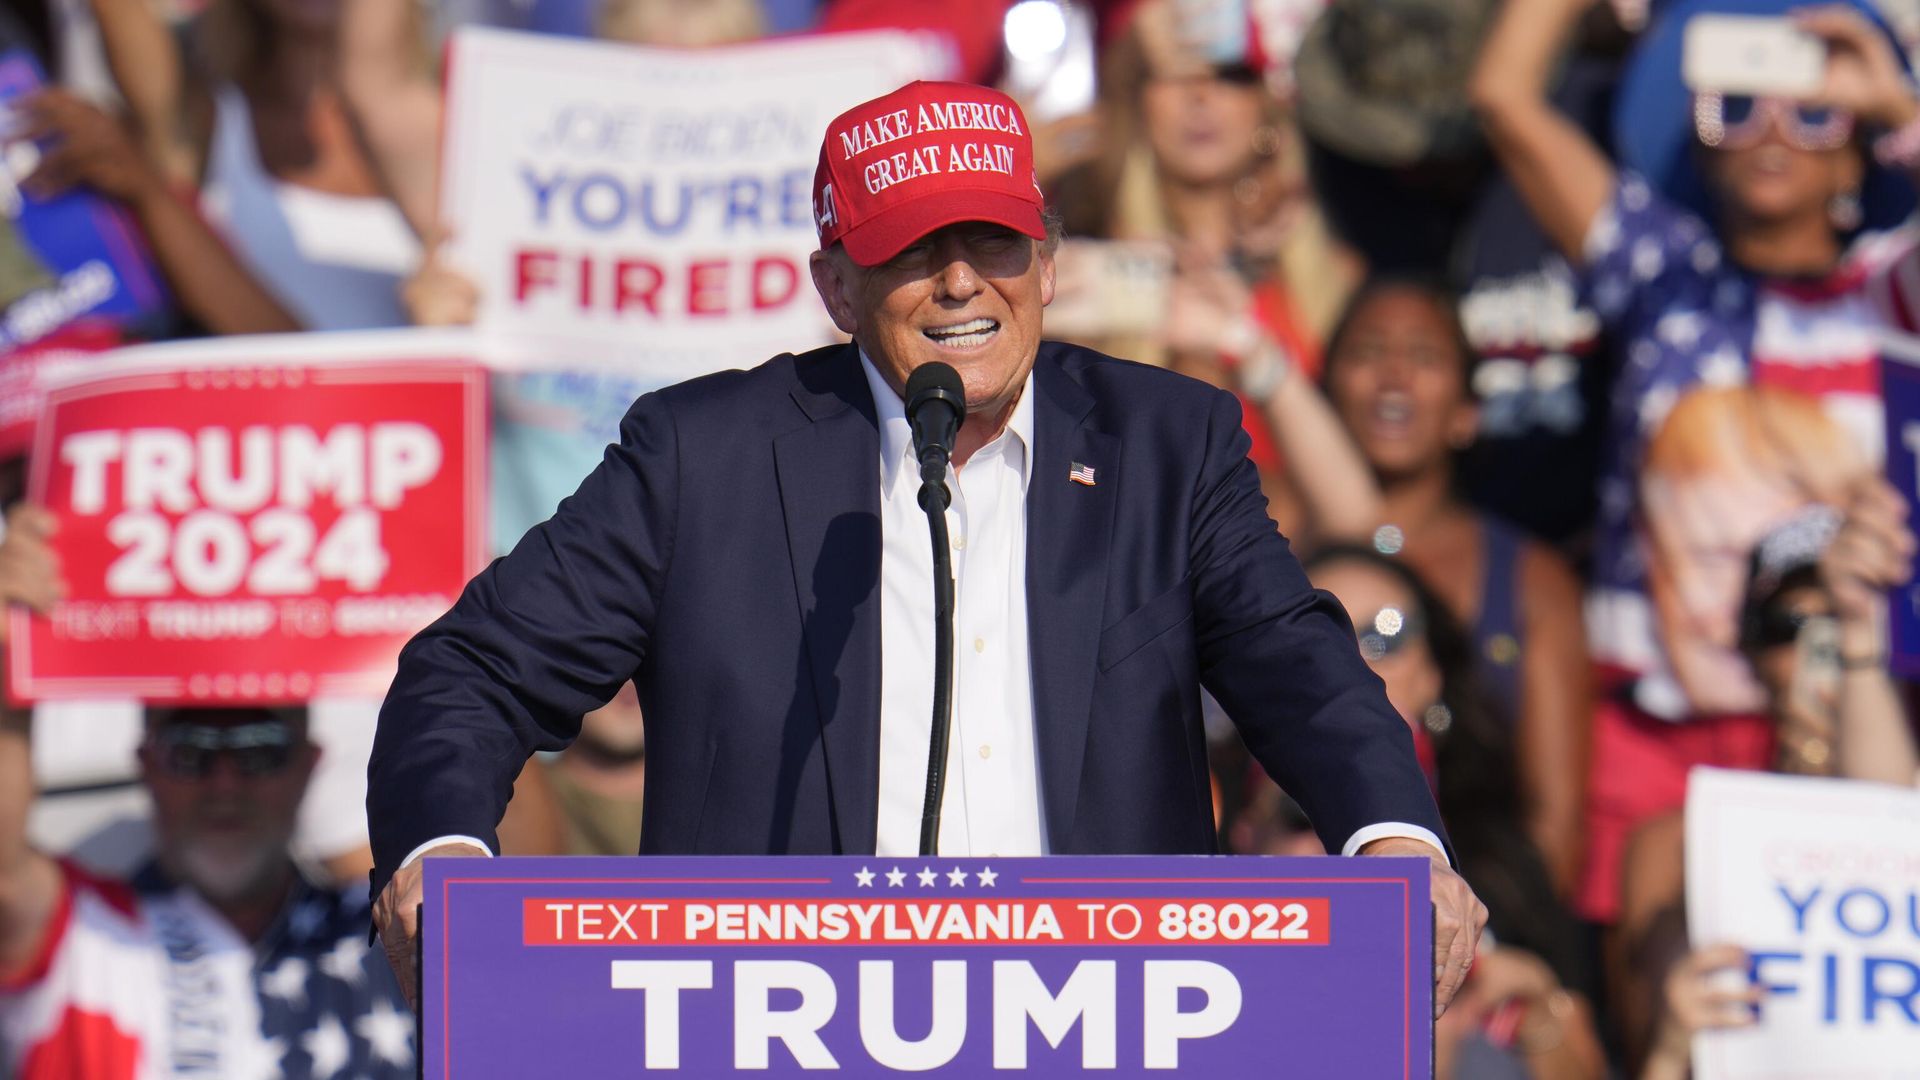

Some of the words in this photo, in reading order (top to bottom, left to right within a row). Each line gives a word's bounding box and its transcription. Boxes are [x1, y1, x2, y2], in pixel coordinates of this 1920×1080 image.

[839, 109, 912, 160] MAKE
[916, 102, 1023, 136] AMERICA
[516, 164, 813, 235] YOU'RE
[864, 145, 941, 195] GREAT
[948, 143, 1014, 177] AGAIN
[513, 248, 799, 318] FIRED
[60, 421, 443, 514] TRUMP
[105, 508, 388, 596] 2024
[545, 903, 669, 940] TEXT
[684, 903, 1064, 940] PENNSYLVANIA
[1077, 903, 1143, 941] TO
[1157, 903, 1310, 941] 88022
[1776, 881, 1920, 939] YO
[610, 959, 1243, 1073] TRUMP
